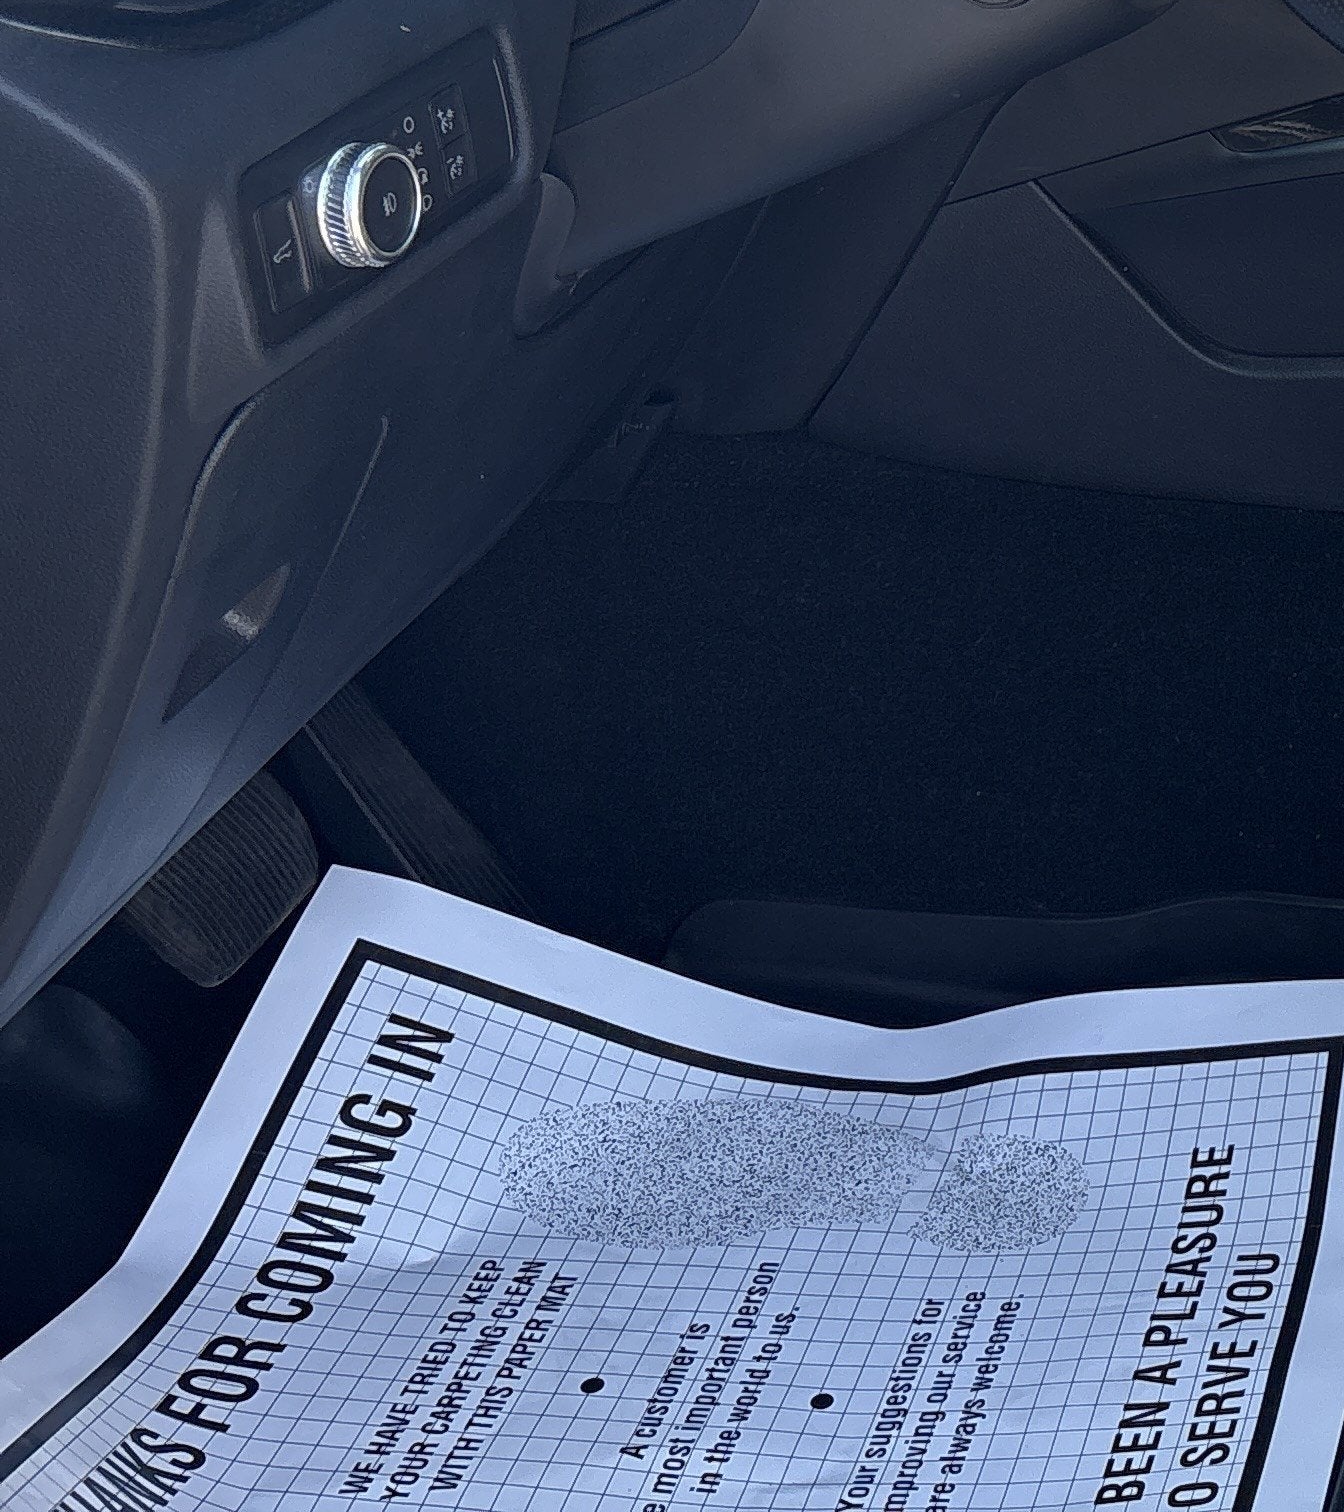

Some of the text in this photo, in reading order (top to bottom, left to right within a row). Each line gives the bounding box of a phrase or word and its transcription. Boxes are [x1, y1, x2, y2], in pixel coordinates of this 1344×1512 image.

[155, 1335, 287, 1433] FOR
[235, 1092, 418, 1324] COMING
[384, 1011, 456, 1083] IN
[1094, 1144, 1235, 1505] BEEN A PLEASURE
[338, 1259, 505, 1494] WE HAVE TRIED TO KEEP
[380, 1261, 548, 1502] YOUR CARPETING CLEAN
[428, 1272, 578, 1491] WITH THIS PAPER MAT
[620, 1323, 710, 1460] A customer is
[652, 1437, 694, 1494] most
[673, 1335, 744, 1431] important
[732, 1261, 780, 1329] person
[690, 1306, 800, 1493] in the world to us.
[834, 1298, 945, 1512] Your suggestions for
[883, 1291, 986, 1512] mproving our service
[940, 1397, 987, 1474] always
[971, 1293, 1025, 1395] welcome.
[1167, 1252, 1280, 1508] O SERVE YOU
